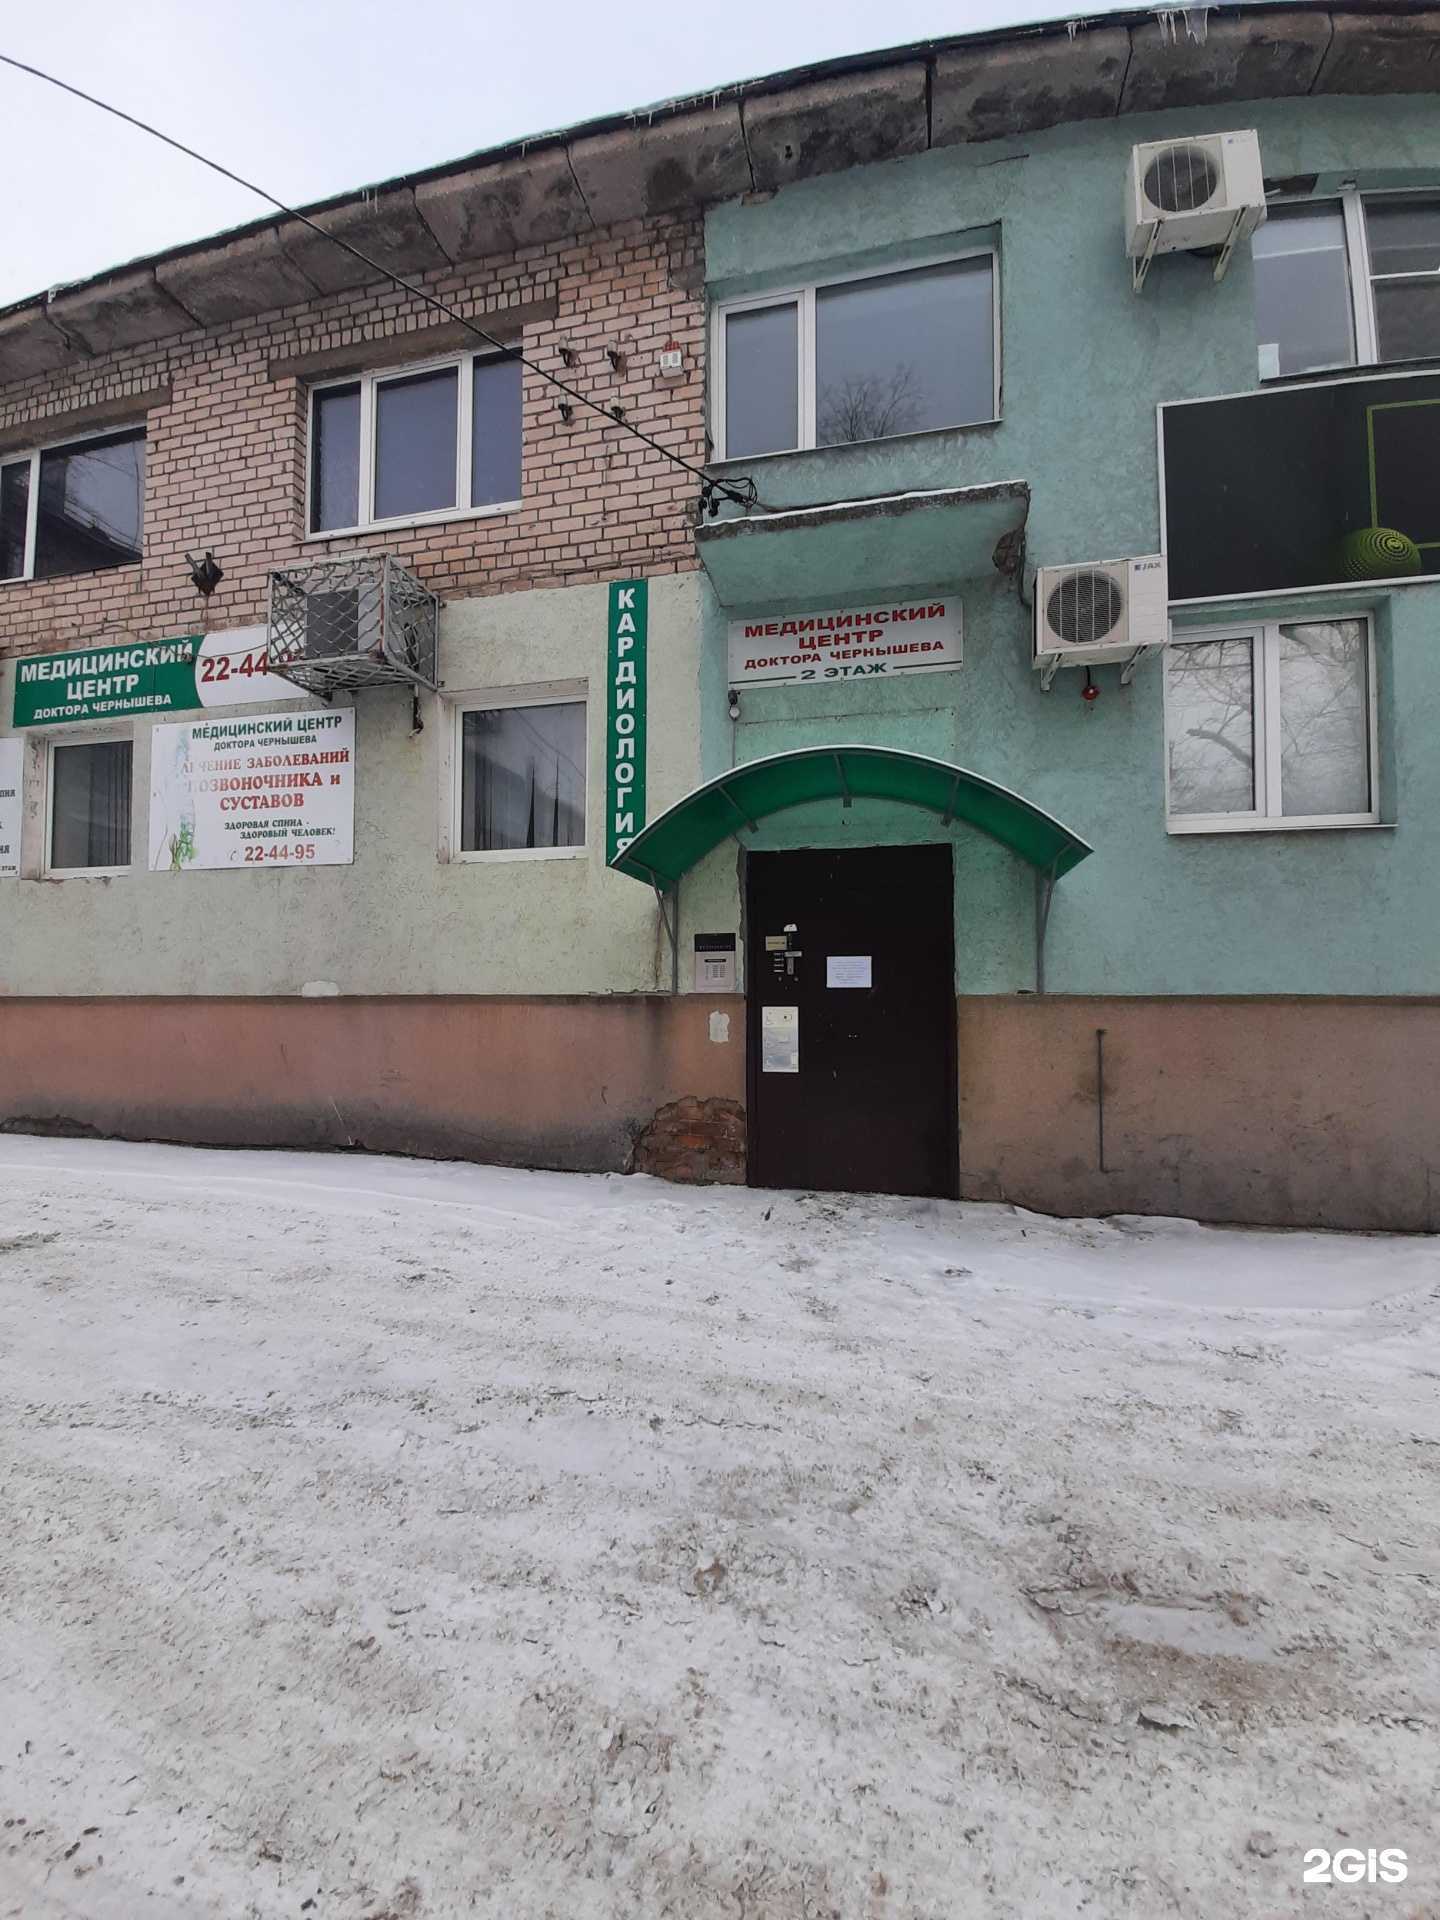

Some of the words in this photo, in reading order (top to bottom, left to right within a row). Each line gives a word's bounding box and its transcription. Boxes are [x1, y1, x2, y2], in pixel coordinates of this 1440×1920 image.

[744, 602, 946, 638] МЕДИЦИНСКИЙ
[798, 629, 884, 651] ЦЕНТР
[20, 639, 194, 683] МЕДИЦИНСКИЙ
[744, 652, 822, 670] ДОКТОРА
[830, 641, 945, 661] ЧЕРНЫШЕВА
[800, 669, 816, 681] 2
[823, 662, 887, 678] ЭТАЖ
[66, 674, 139, 701] ЦЕНТР
[33, 703, 90, 720] ДОКТОРА
[92, 694, 172, 713] ЧЕРНЫШЕВА
[192, 718, 293, 740] МЕДИЦИНСКИЙ
[297, 715, 343, 733] ЦЕНТР
[213, 738, 256, 751] ДОКТОРА
[257, 734, 318, 747] ЧЕРНЫШЕВА
[182, 758, 242, 774] ЛЧЕНИЕ
[247, 748, 350, 769] ЗАБОЛЕВАНИЙ
[219, 793, 305, 811] СУСТАВОВ
[224, 820, 269, 830] ЗДОРОВАЯ
[271, 819, 303, 828] СПИНА
[240, 828, 288, 839] ЗДОРОВЫЙ
[244, 843, 316, 862] 22-44-95
